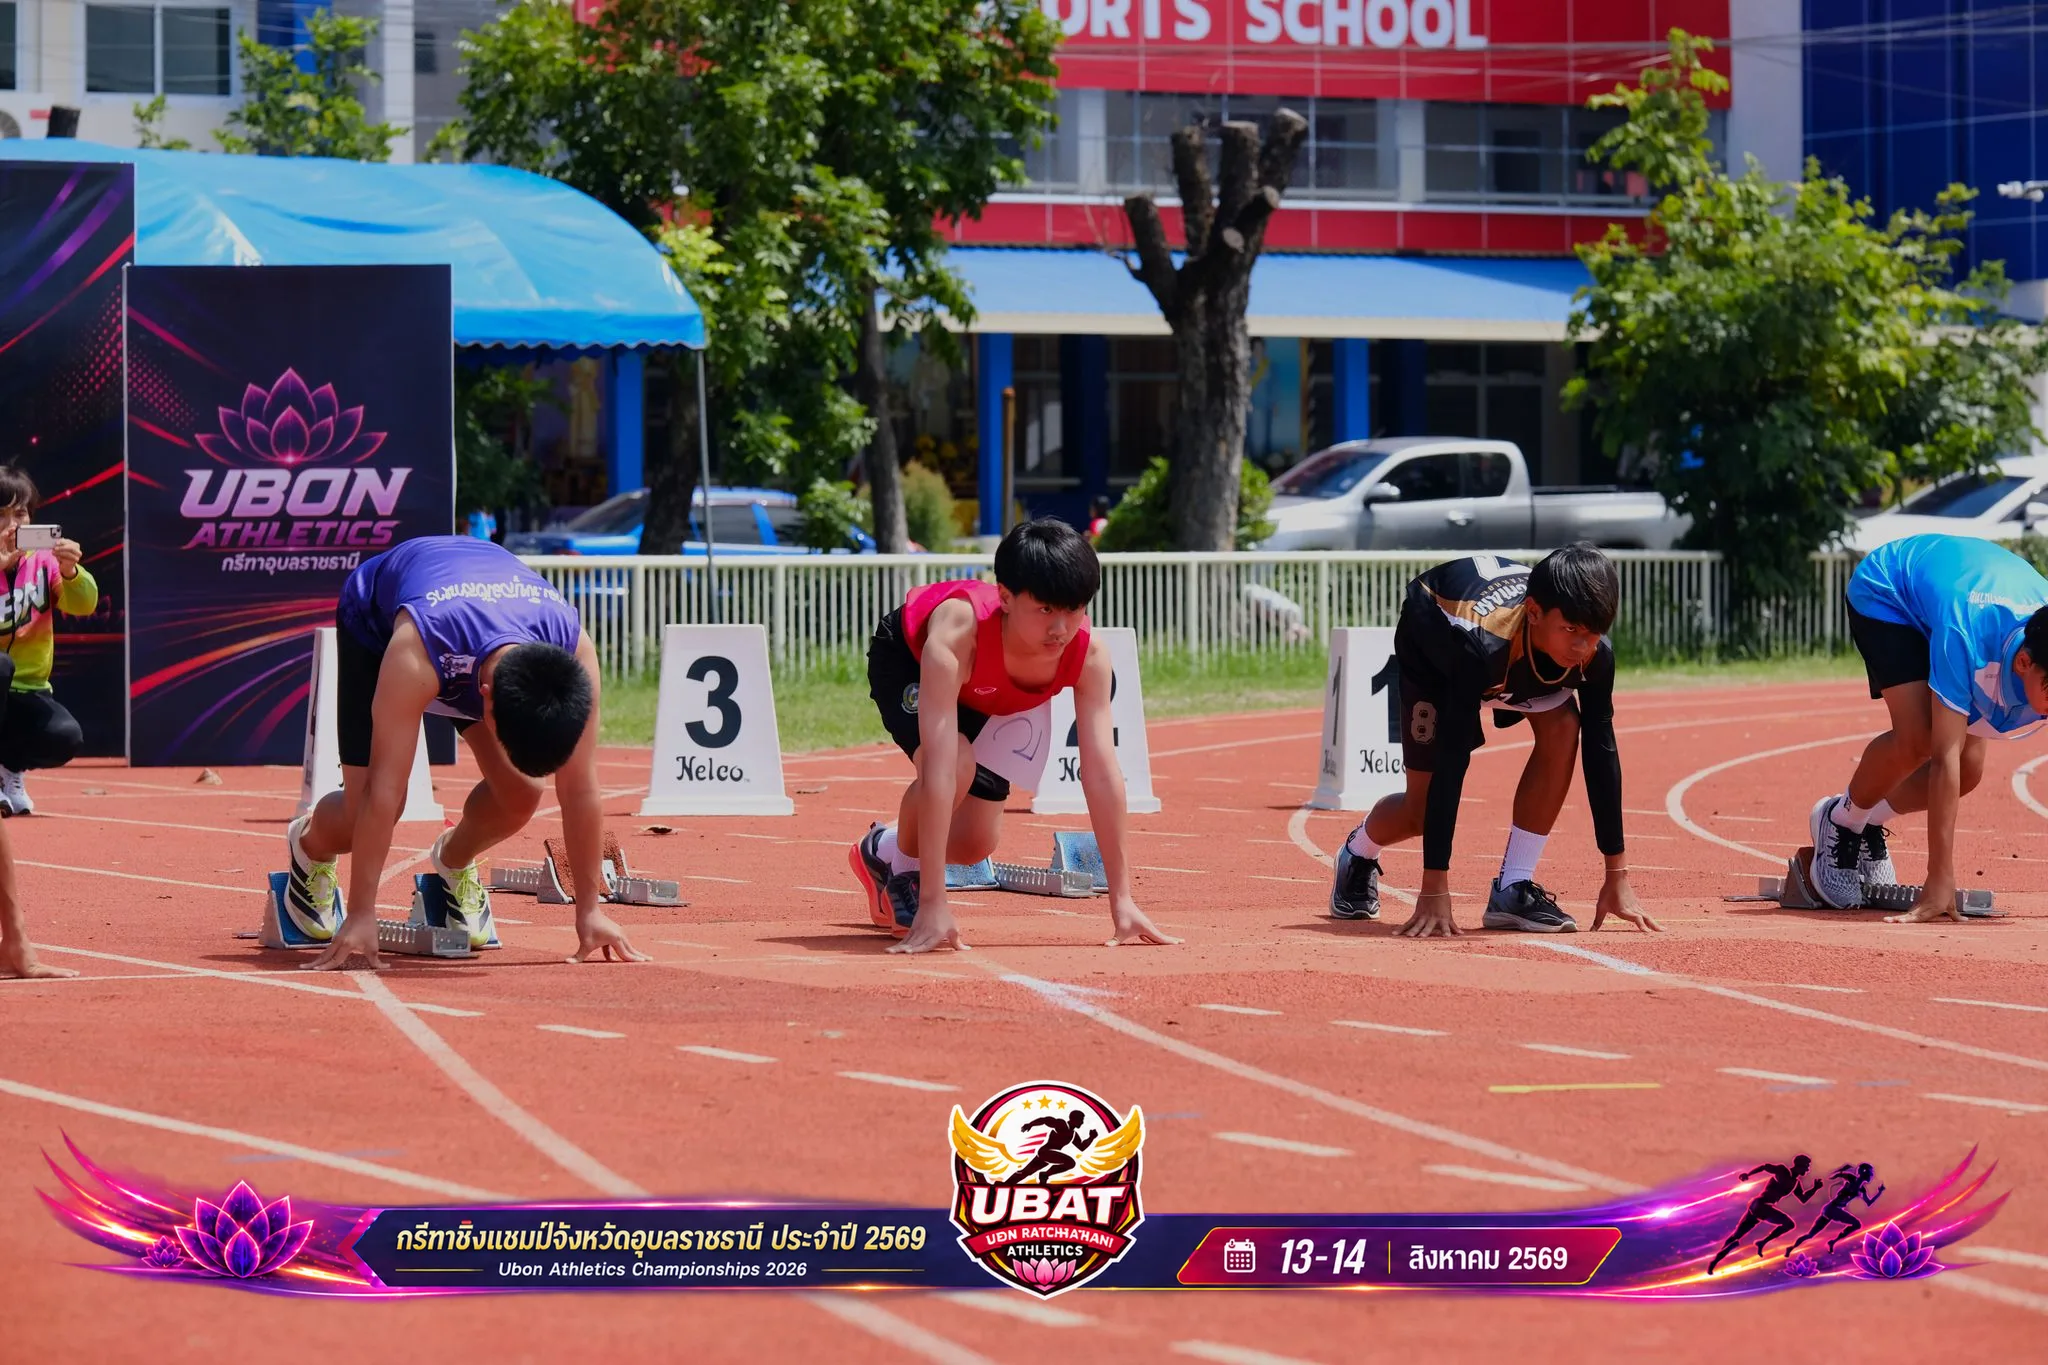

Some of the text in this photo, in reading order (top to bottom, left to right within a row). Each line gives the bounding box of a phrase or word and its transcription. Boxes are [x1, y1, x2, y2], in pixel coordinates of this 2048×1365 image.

[1041, 0, 1488, 49] ORTS SCHOOL
[179, 467, 414, 518] UBON
[181, 520, 403, 549] ATHLETICS
[685, 655, 742, 749] 3
[1371, 654, 1402, 744] 1
[1411, 700, 1437, 744] 8
[676, 756, 744, 783] Nelco
